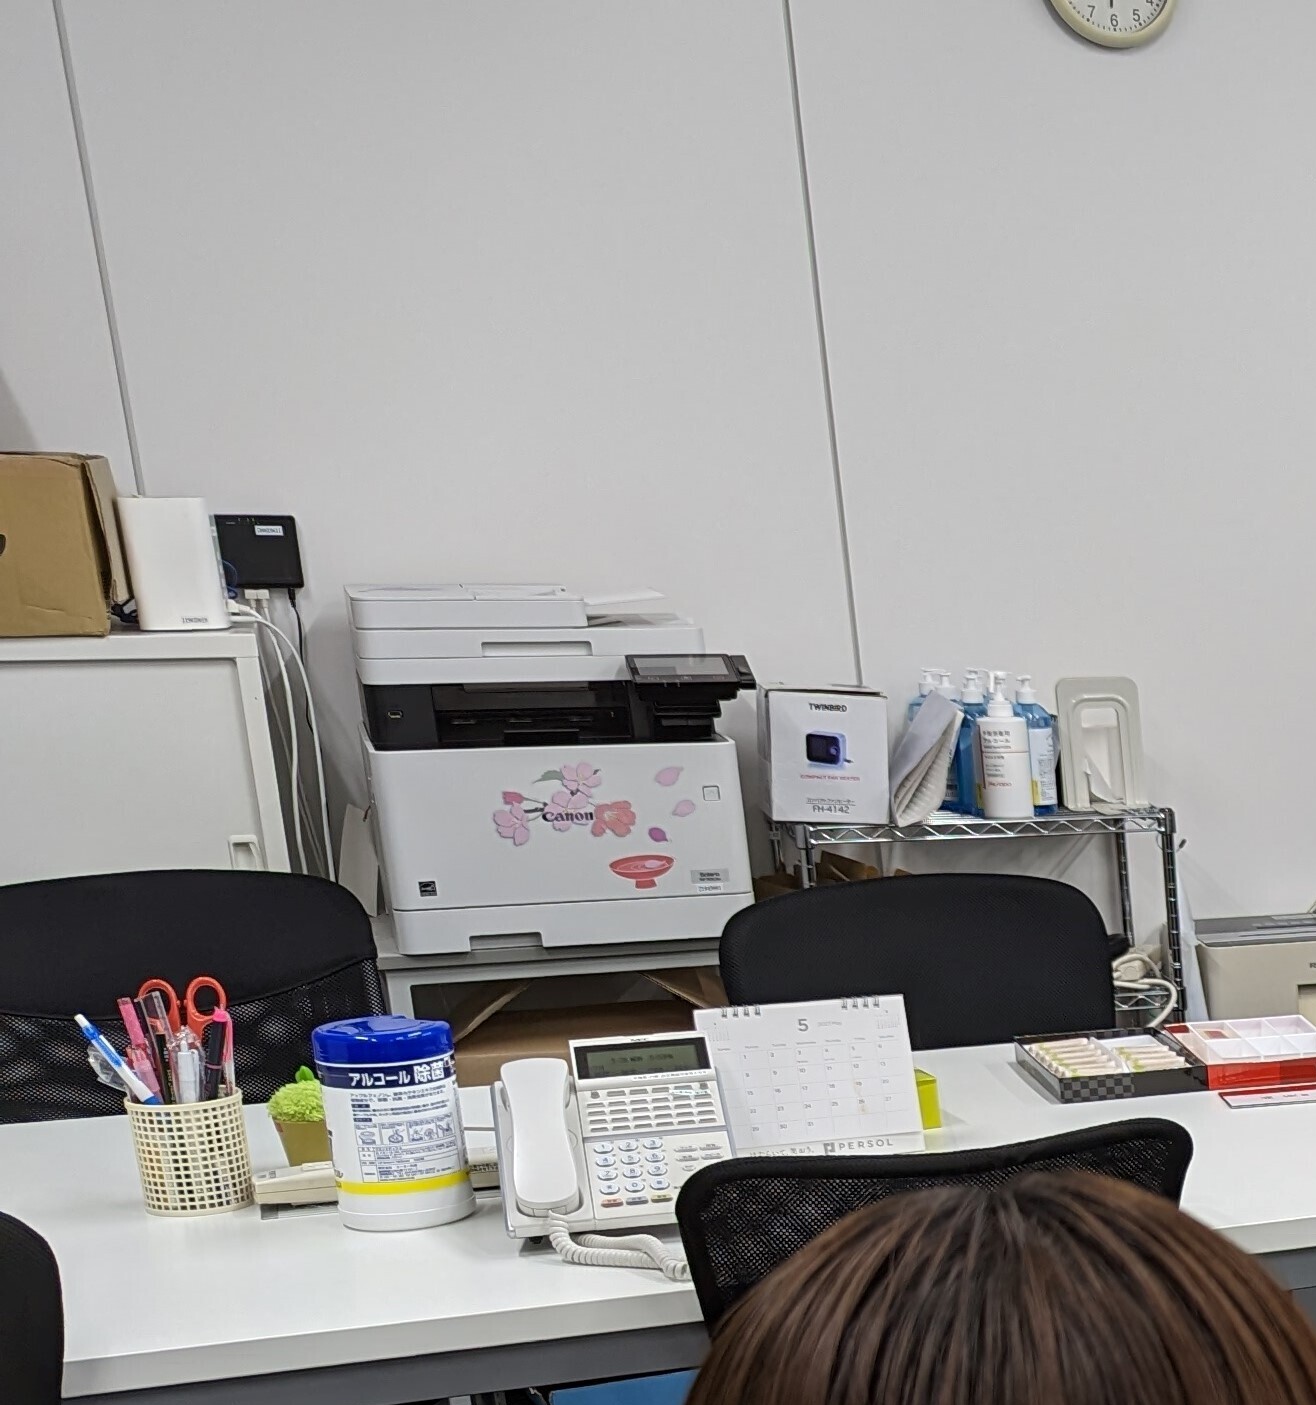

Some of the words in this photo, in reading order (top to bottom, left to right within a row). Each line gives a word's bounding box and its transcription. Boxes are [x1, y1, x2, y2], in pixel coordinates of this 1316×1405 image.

[1087, 5, 1095, 18] 7
[1132, 9, 1141, 22] 5
[1110, 14, 1119, 27] 6
[808, 702, 847, 713] TWINBIRD
[542, 810, 594, 822] Canon
[812, 804, 850, 815] FH-4142
[797, 1018, 809, 1032] 5
[348, 1071, 411, 1087] アルコール
[413, 1062, 445, 1084] 除菌
[838, 1139, 894, 1151] PERSOL
